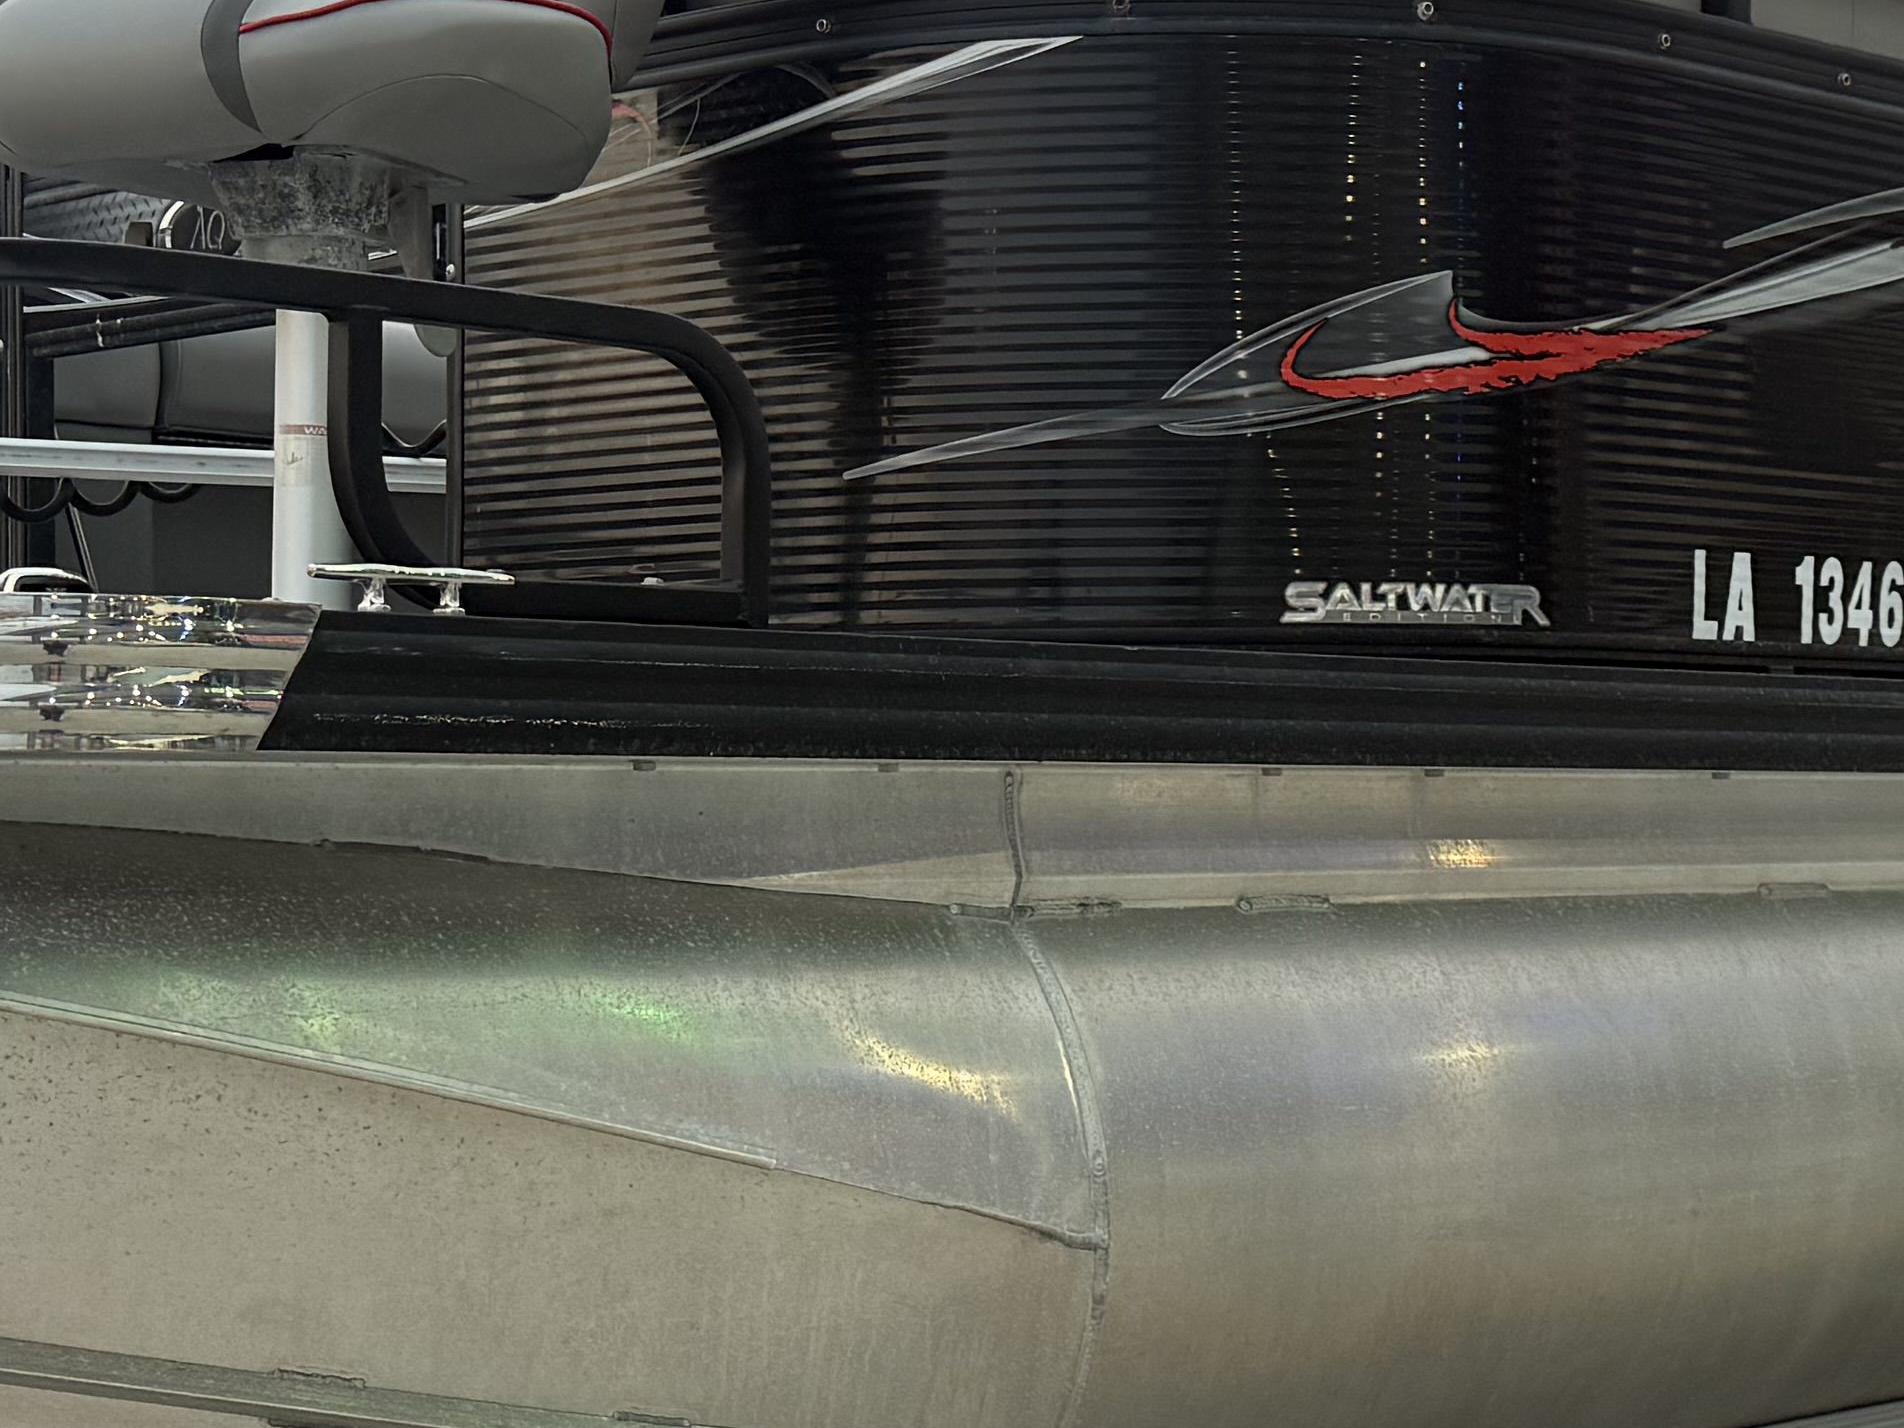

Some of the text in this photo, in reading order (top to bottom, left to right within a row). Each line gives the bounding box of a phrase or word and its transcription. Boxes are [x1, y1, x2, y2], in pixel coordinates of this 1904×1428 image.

[1279, 580, 1551, 627] SALTWATER
[1692, 549, 1756, 642] LA
[1795, 555, 1904, 648] 1346
